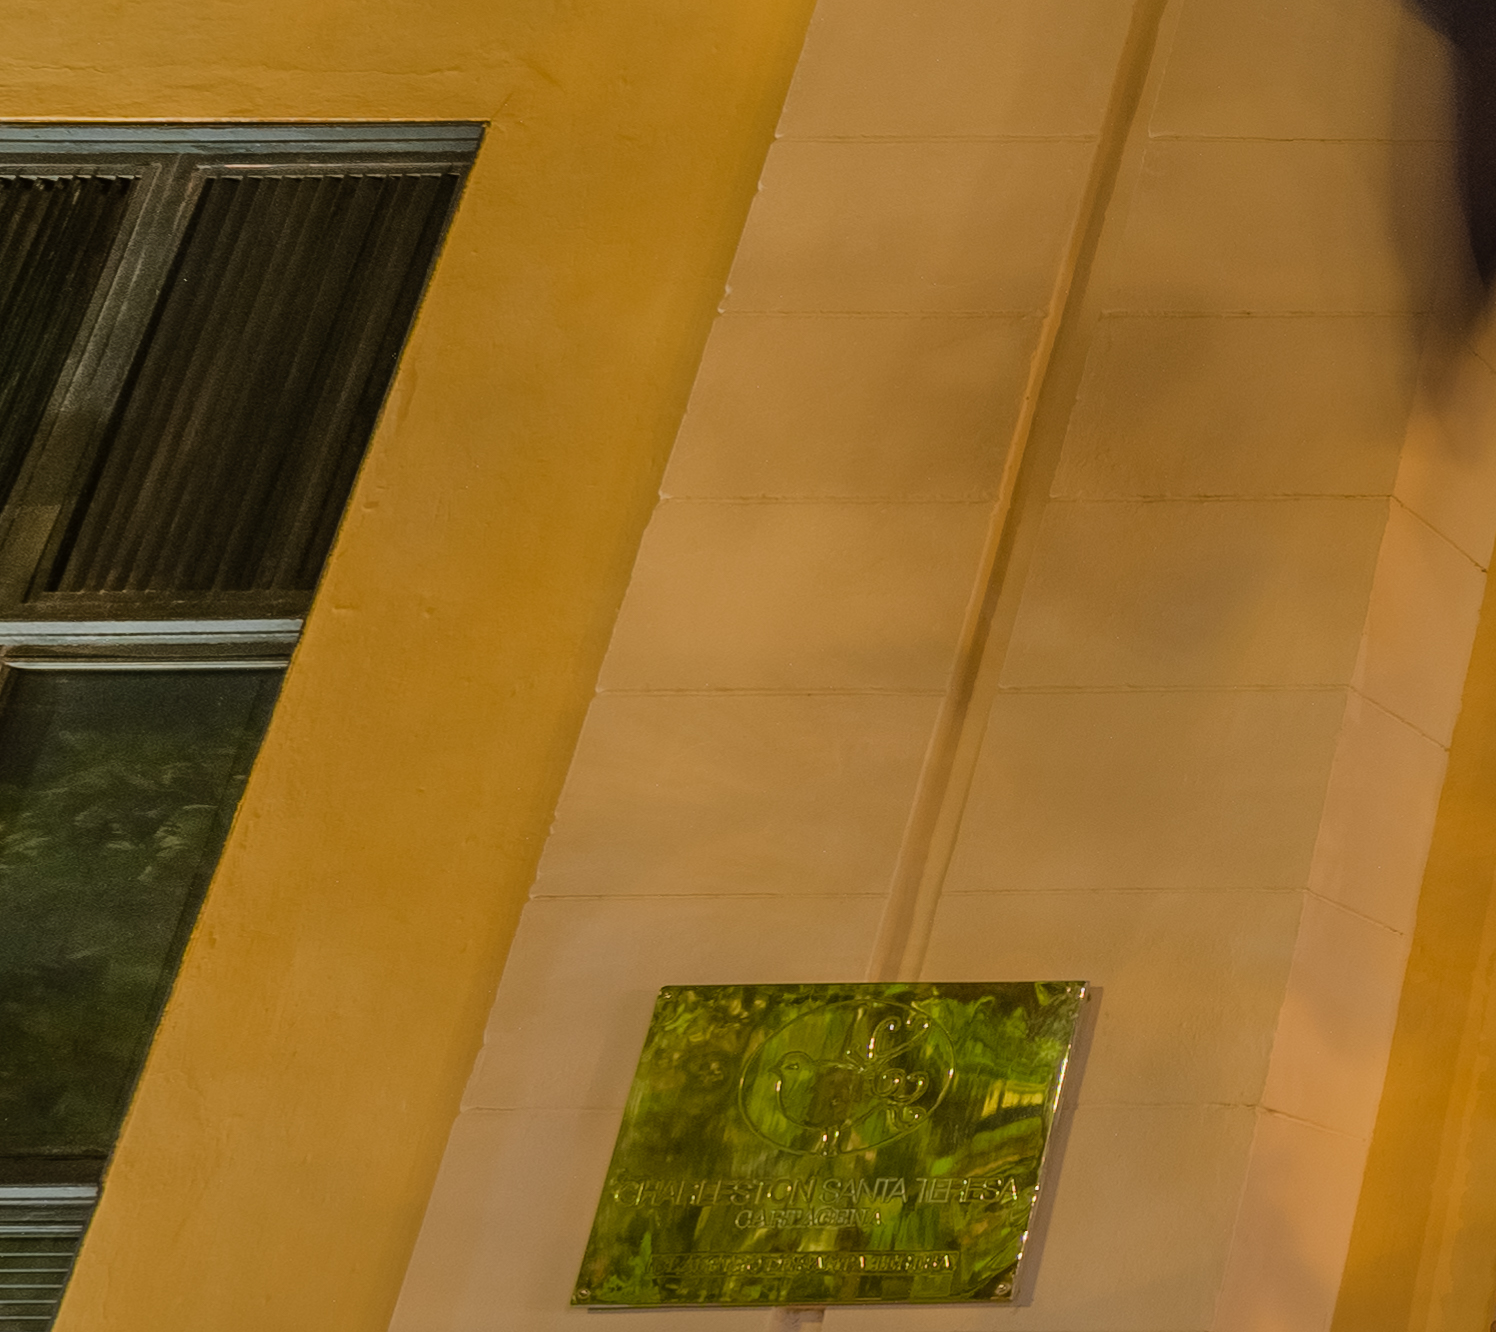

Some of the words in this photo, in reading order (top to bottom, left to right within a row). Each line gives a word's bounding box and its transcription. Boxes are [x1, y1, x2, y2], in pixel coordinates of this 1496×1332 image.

[819, 1176, 908, 1206] SANTA
[916, 1176, 1018, 1205] TERESA
[734, 1207, 882, 1230] CARTAGENA
